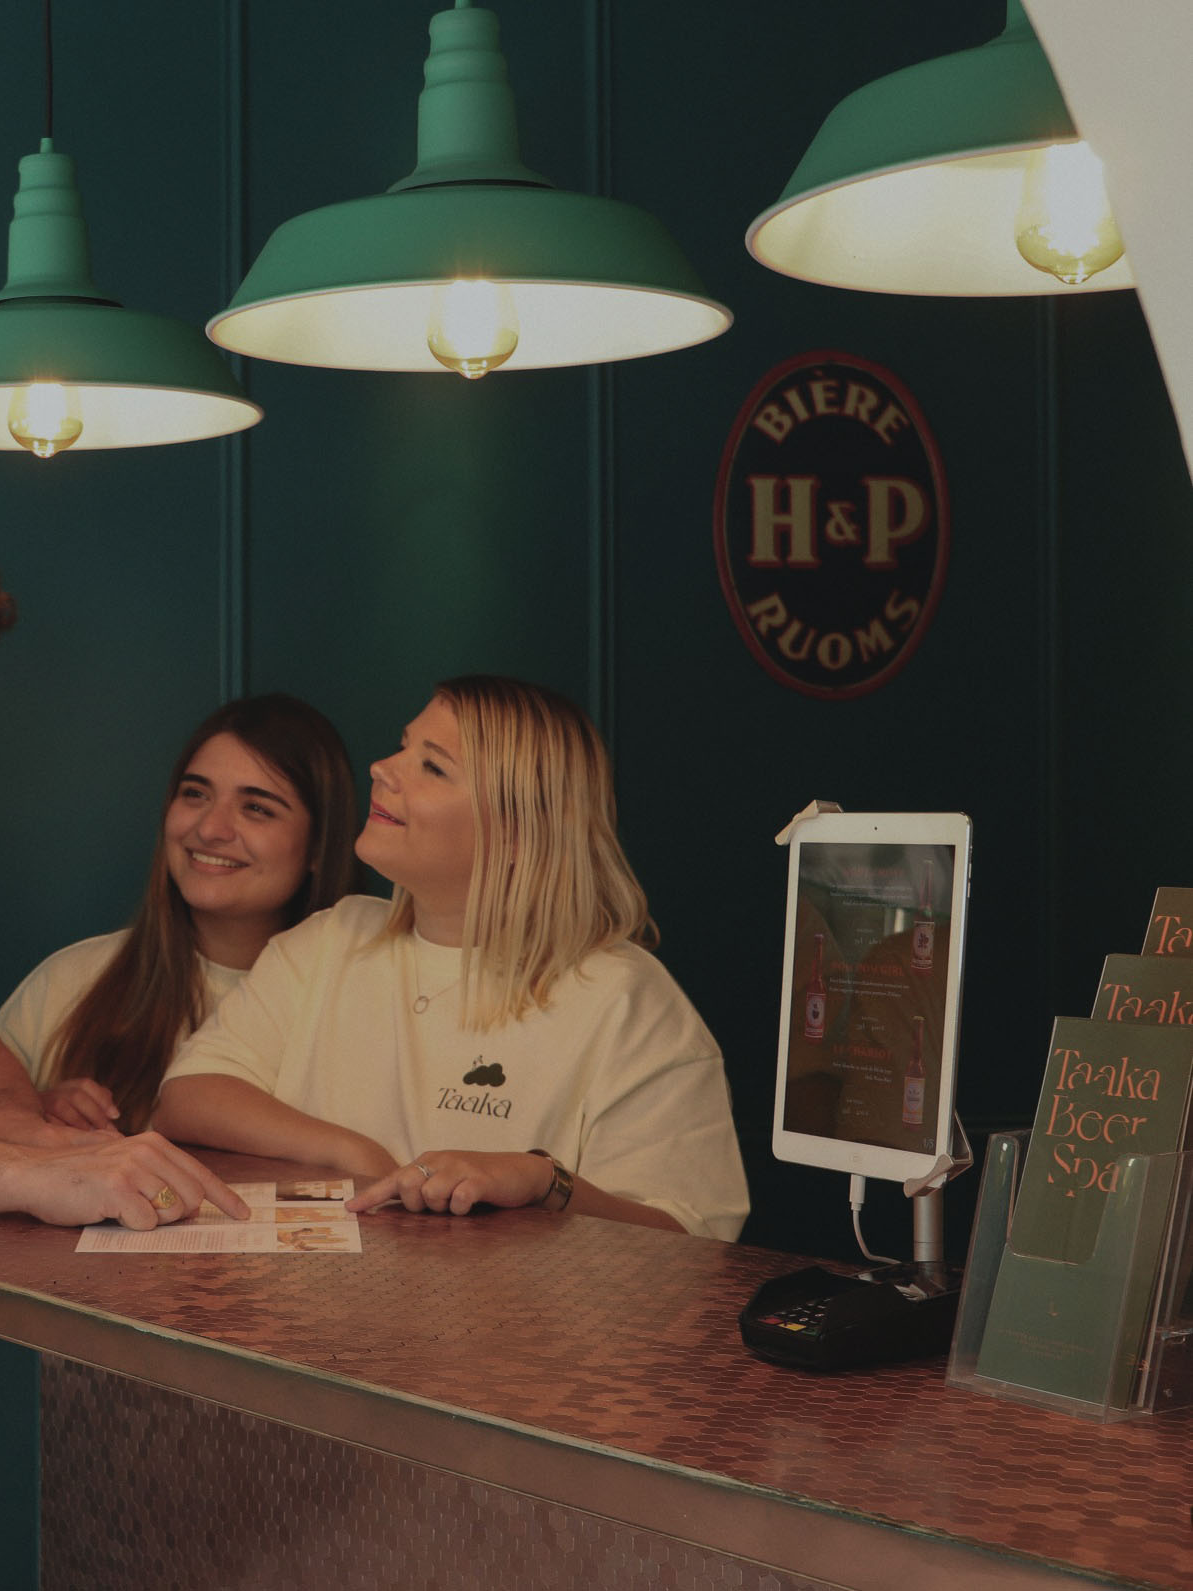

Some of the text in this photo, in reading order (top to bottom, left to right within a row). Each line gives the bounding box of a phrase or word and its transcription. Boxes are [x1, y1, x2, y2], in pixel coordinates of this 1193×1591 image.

[752, 369, 910, 446] BIÈRE
[747, 590, 922, 670] RUOMS
[1102, 984, 1193, 1025] Taak
[1053, 1048, 1161, 1102] Taaka
[436, 1087, 512, 1119] Taaka
[1045, 1094, 1150, 1145] Beer
[1047, 1142, 1121, 1198] Spa
